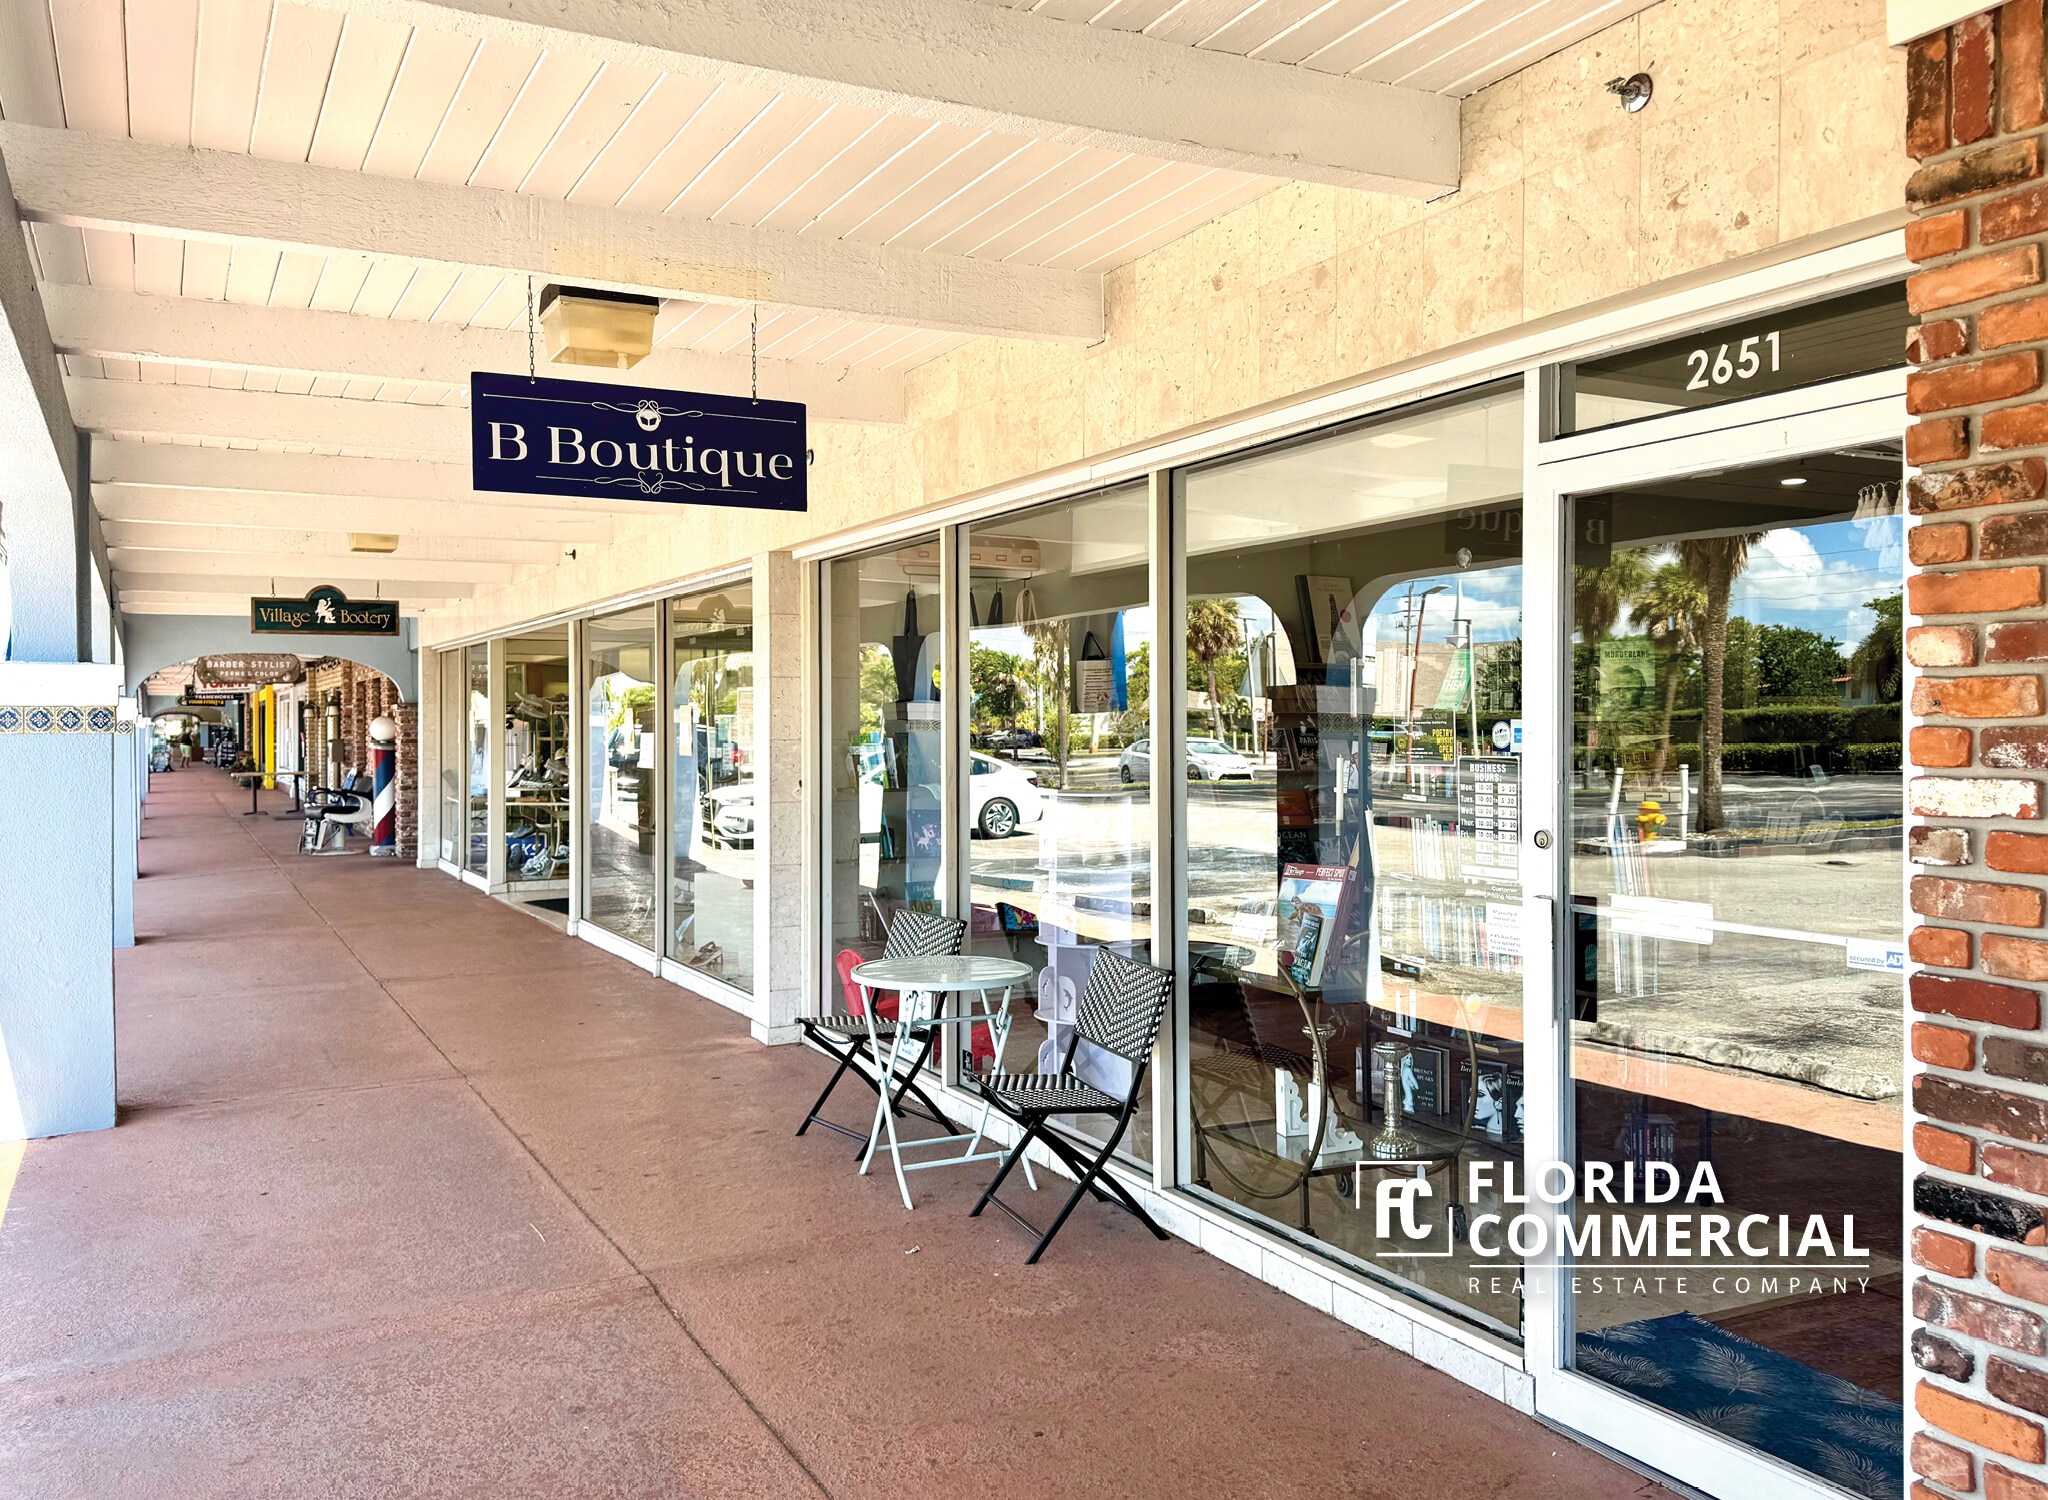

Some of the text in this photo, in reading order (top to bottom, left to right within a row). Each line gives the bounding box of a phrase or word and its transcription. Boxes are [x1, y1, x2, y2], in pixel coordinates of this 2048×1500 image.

[1686, 331, 1781, 391] 2651
[487, 421, 794, 487] B Boutique
[260, 608, 390, 628] Village Bootery
[206, 660, 291, 669] BARBER STYLIST
[1449, 668, 1467, 679] LET
[1442, 679, 1467, 691] THEM
[1432, 728, 1453, 737] POETRY
[1299, 736, 1318, 744] PARIS
[1439, 745, 1454, 753] OPEN
[1469, 763, 1507, 773] BUSINESS
[1474, 773, 1502, 782] HOURS:
[1460, 795, 1475, 803] Tues.
[1460, 807, 1474, 815] Wed.
[1460, 819, 1475, 827] Thur.
[1491, 885, 1518, 893] Customer
[1849, 955, 1876, 963] secured
[1886, 953, 1904, 967] AD
[1413, 1067, 1433, 1075] BRITNEY
